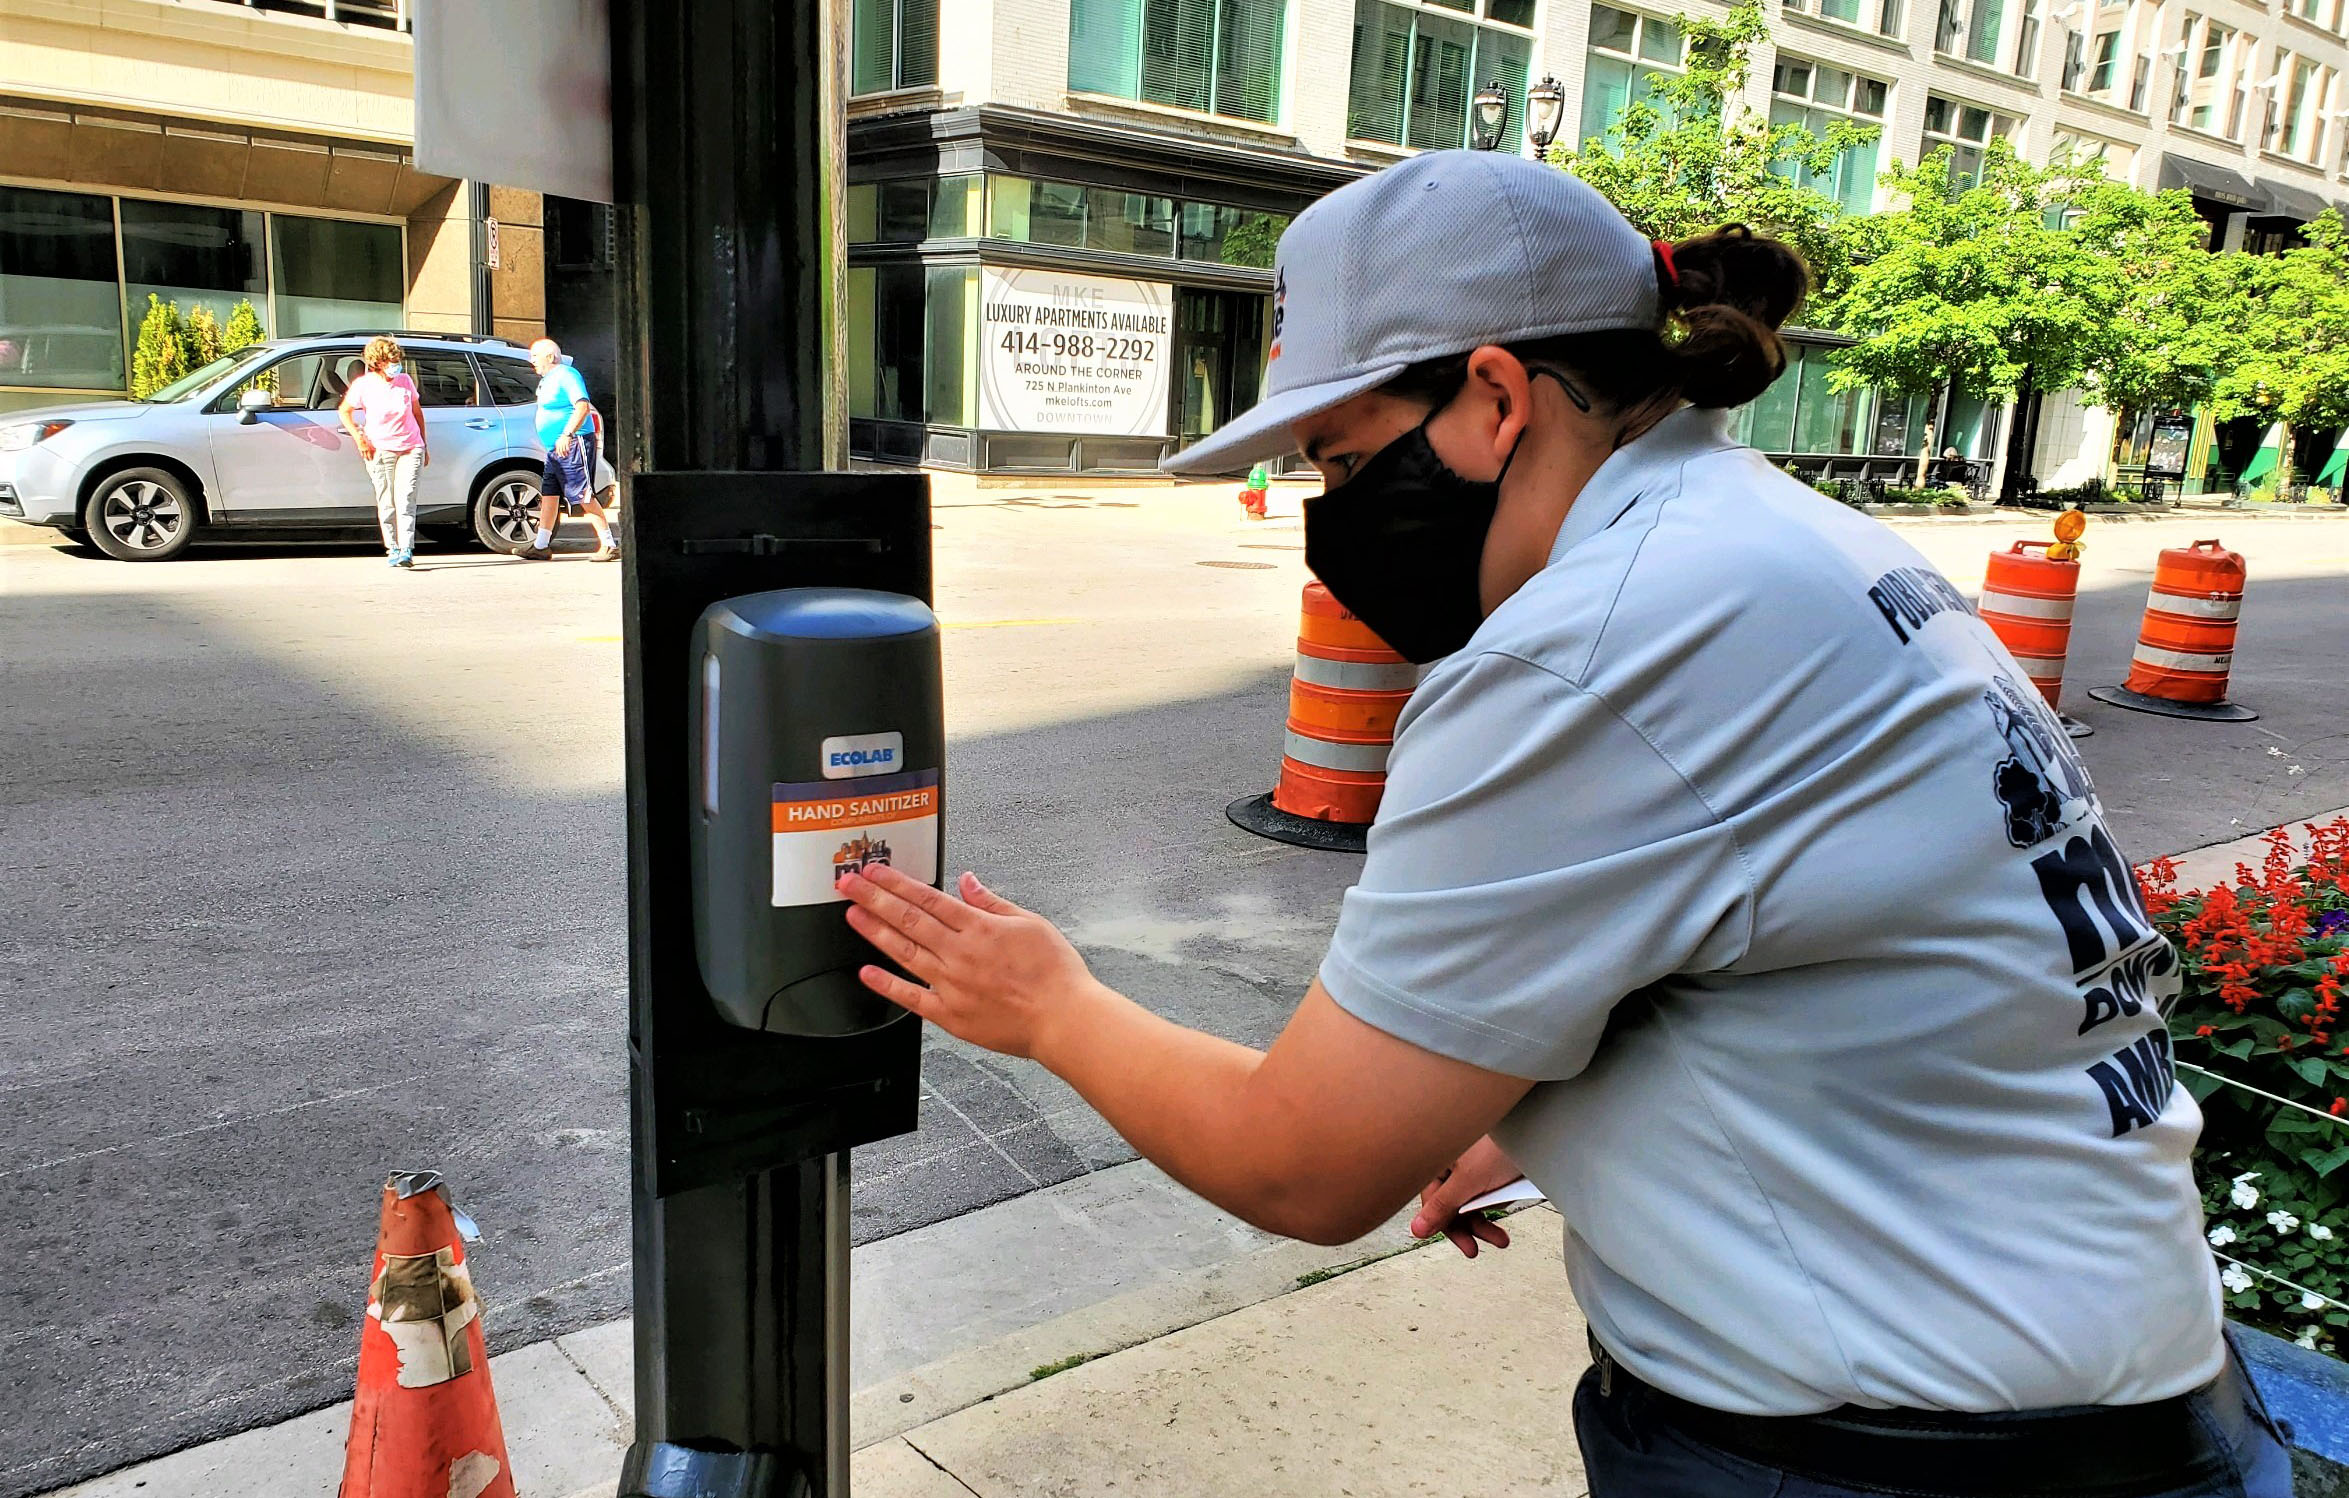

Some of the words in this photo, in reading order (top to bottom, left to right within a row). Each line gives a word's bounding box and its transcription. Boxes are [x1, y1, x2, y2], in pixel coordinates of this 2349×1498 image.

[1053, 284, 1104, 308] MKE
[986, 302, 1032, 324] LUXURY
[1035, 306, 1108, 331] APARTMENTS
[1111, 312, 1167, 335] AVAILABLE
[1001, 330, 1155, 362] 414-988-2292
[1015, 363, 1067, 377] AROUND
[1071, 366, 1093, 378] THE
[1096, 367, 1143, 380] CORNER
[1025, 380, 1044, 391] 725
[1058, 382, 1111, 394] Plankinton
[1113, 384, 1132, 396] Ave
[1045, 396, 1113, 408] mkelofts.com
[1036, 411, 1113, 425] DOWNTOWN
[830, 748, 895, 767] ECOLAB
[788, 803, 845, 821] HAND
[849, 792, 930, 817] SANITIZER
